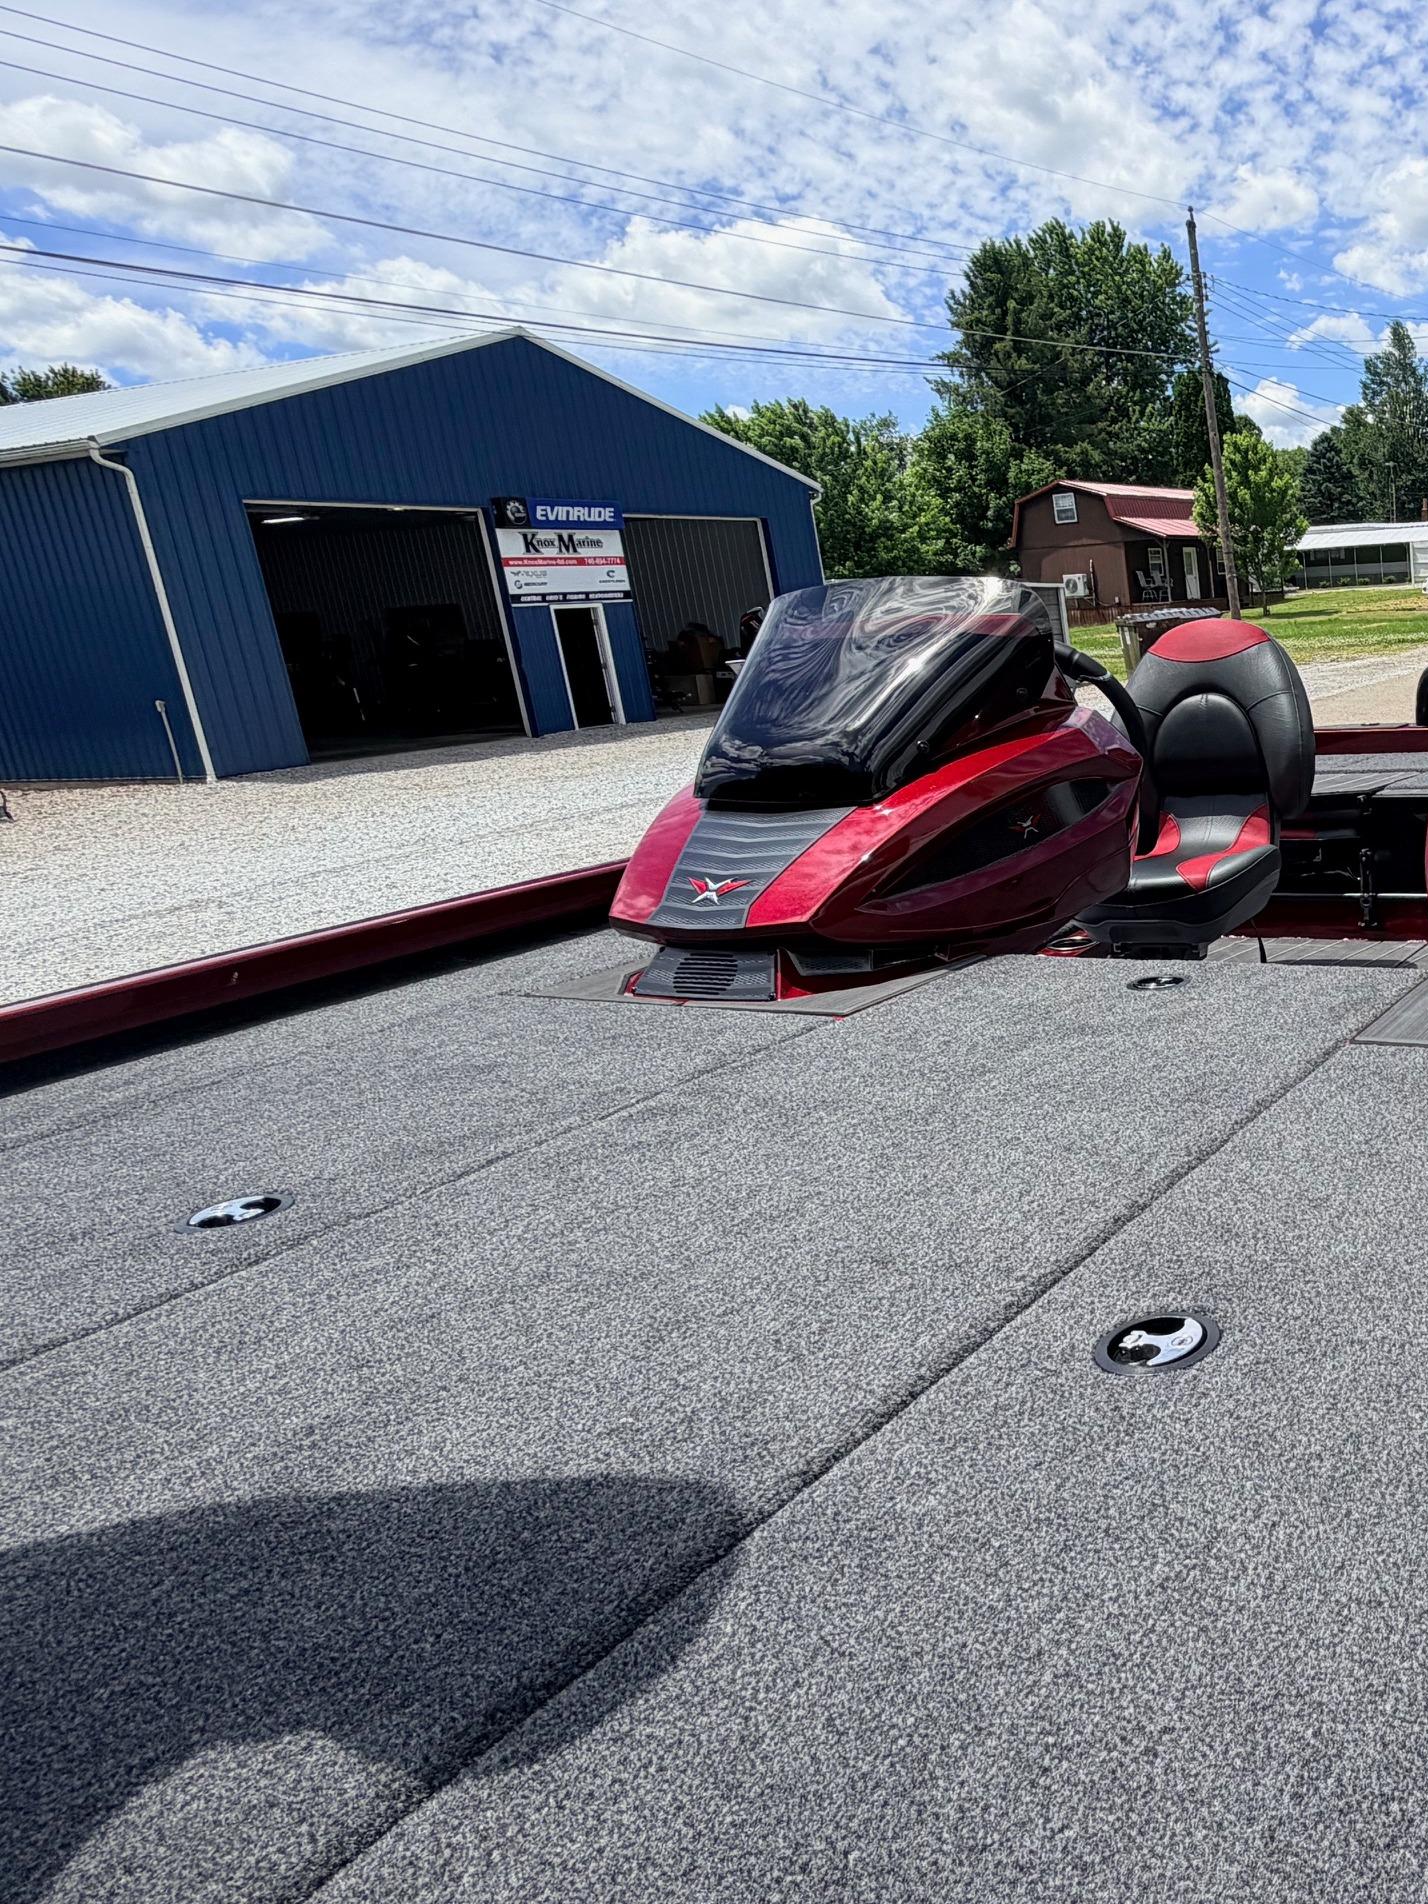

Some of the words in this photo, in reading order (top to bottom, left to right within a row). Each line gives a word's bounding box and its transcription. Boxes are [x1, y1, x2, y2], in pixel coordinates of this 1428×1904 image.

[536, 505, 614, 522] EVINRUDE
[518, 531, 556, 555] Knox
[554, 532, 603, 555] Marine
